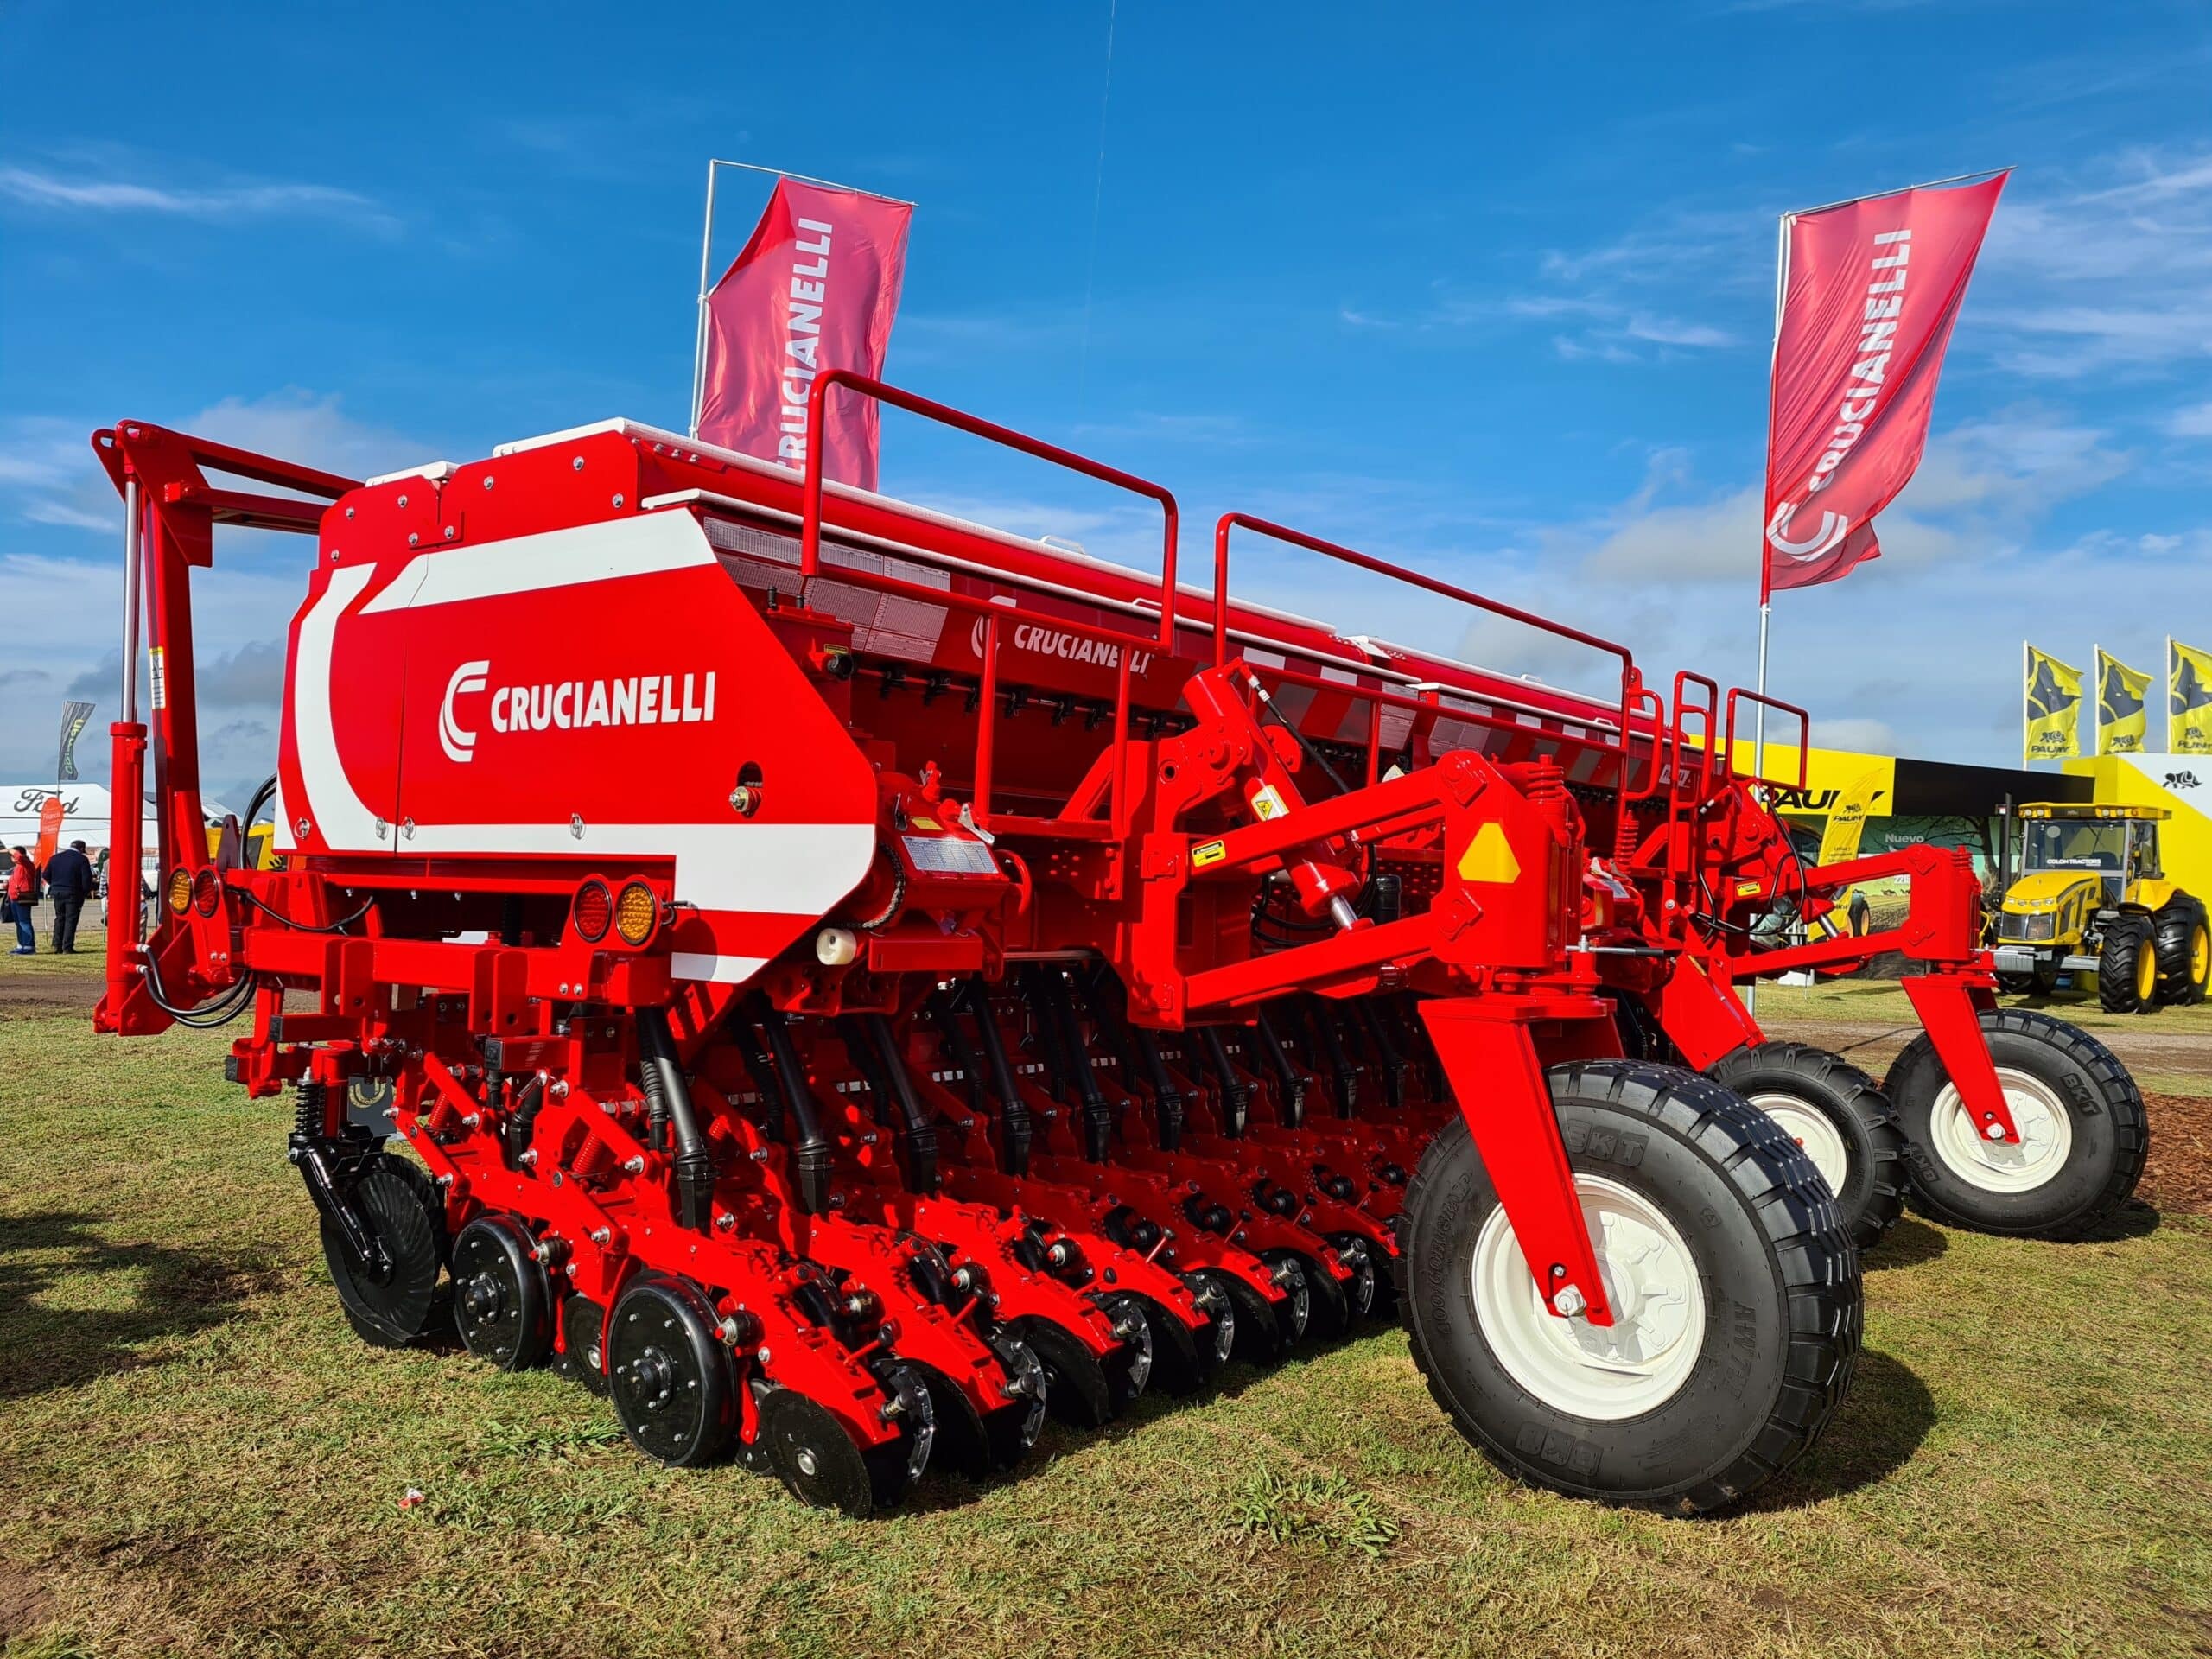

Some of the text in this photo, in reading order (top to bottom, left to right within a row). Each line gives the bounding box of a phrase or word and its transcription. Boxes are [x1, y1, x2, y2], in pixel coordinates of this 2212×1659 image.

[1014, 624, 1150, 674] CRUCIANELI
[491, 671, 715, 733] CRUCIANELLI
[1885, 833, 1925, 843] Nuevo
